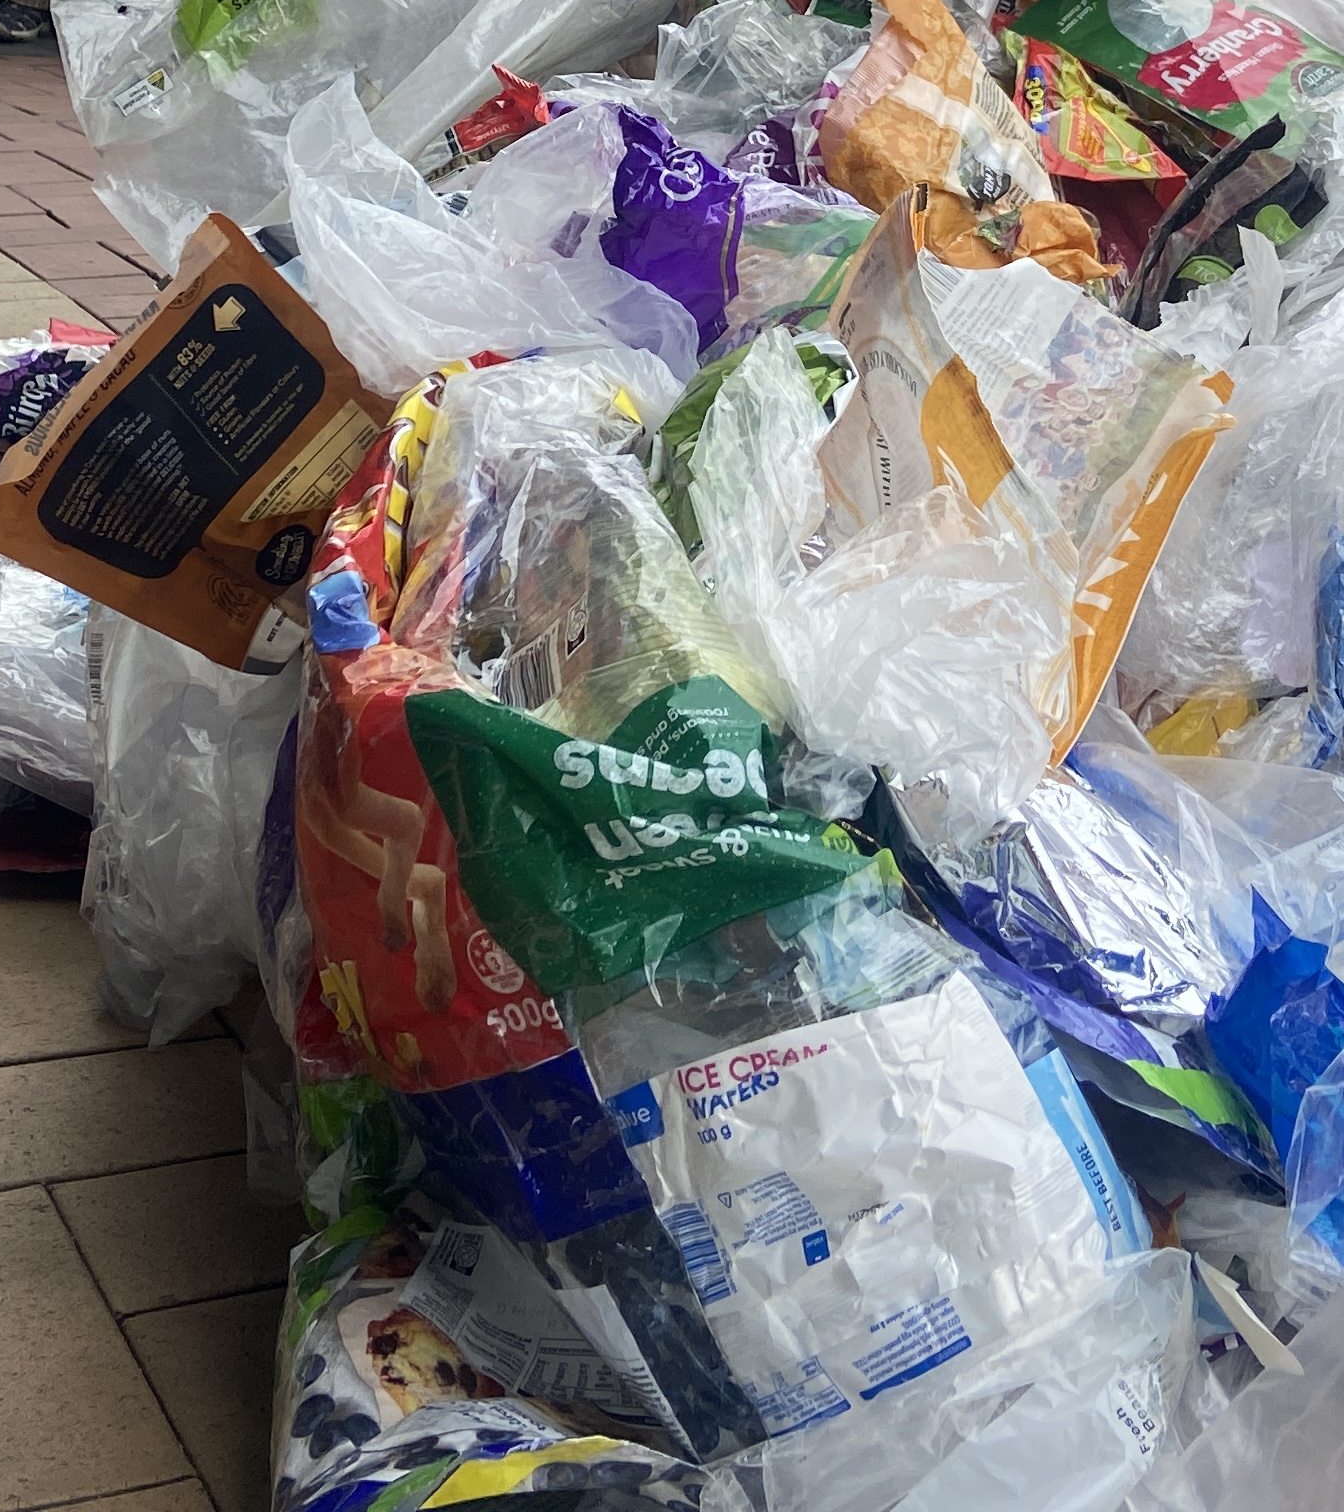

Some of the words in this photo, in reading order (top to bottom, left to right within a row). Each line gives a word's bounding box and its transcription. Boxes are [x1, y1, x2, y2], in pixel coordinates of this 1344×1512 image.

[1160, 16, 1284, 94] Cranberry
[1303, 64, 1334, 88] Earth
[176, 339, 203, 366] 83%
[486, 996, 564, 1037] 500g
[676, 1063, 721, 1094] ICE
[616, 1104, 652, 1133] lue
[1075, 1140, 1109, 1198] BEFORE
[1102, 1197, 1122, 1233] BEST
